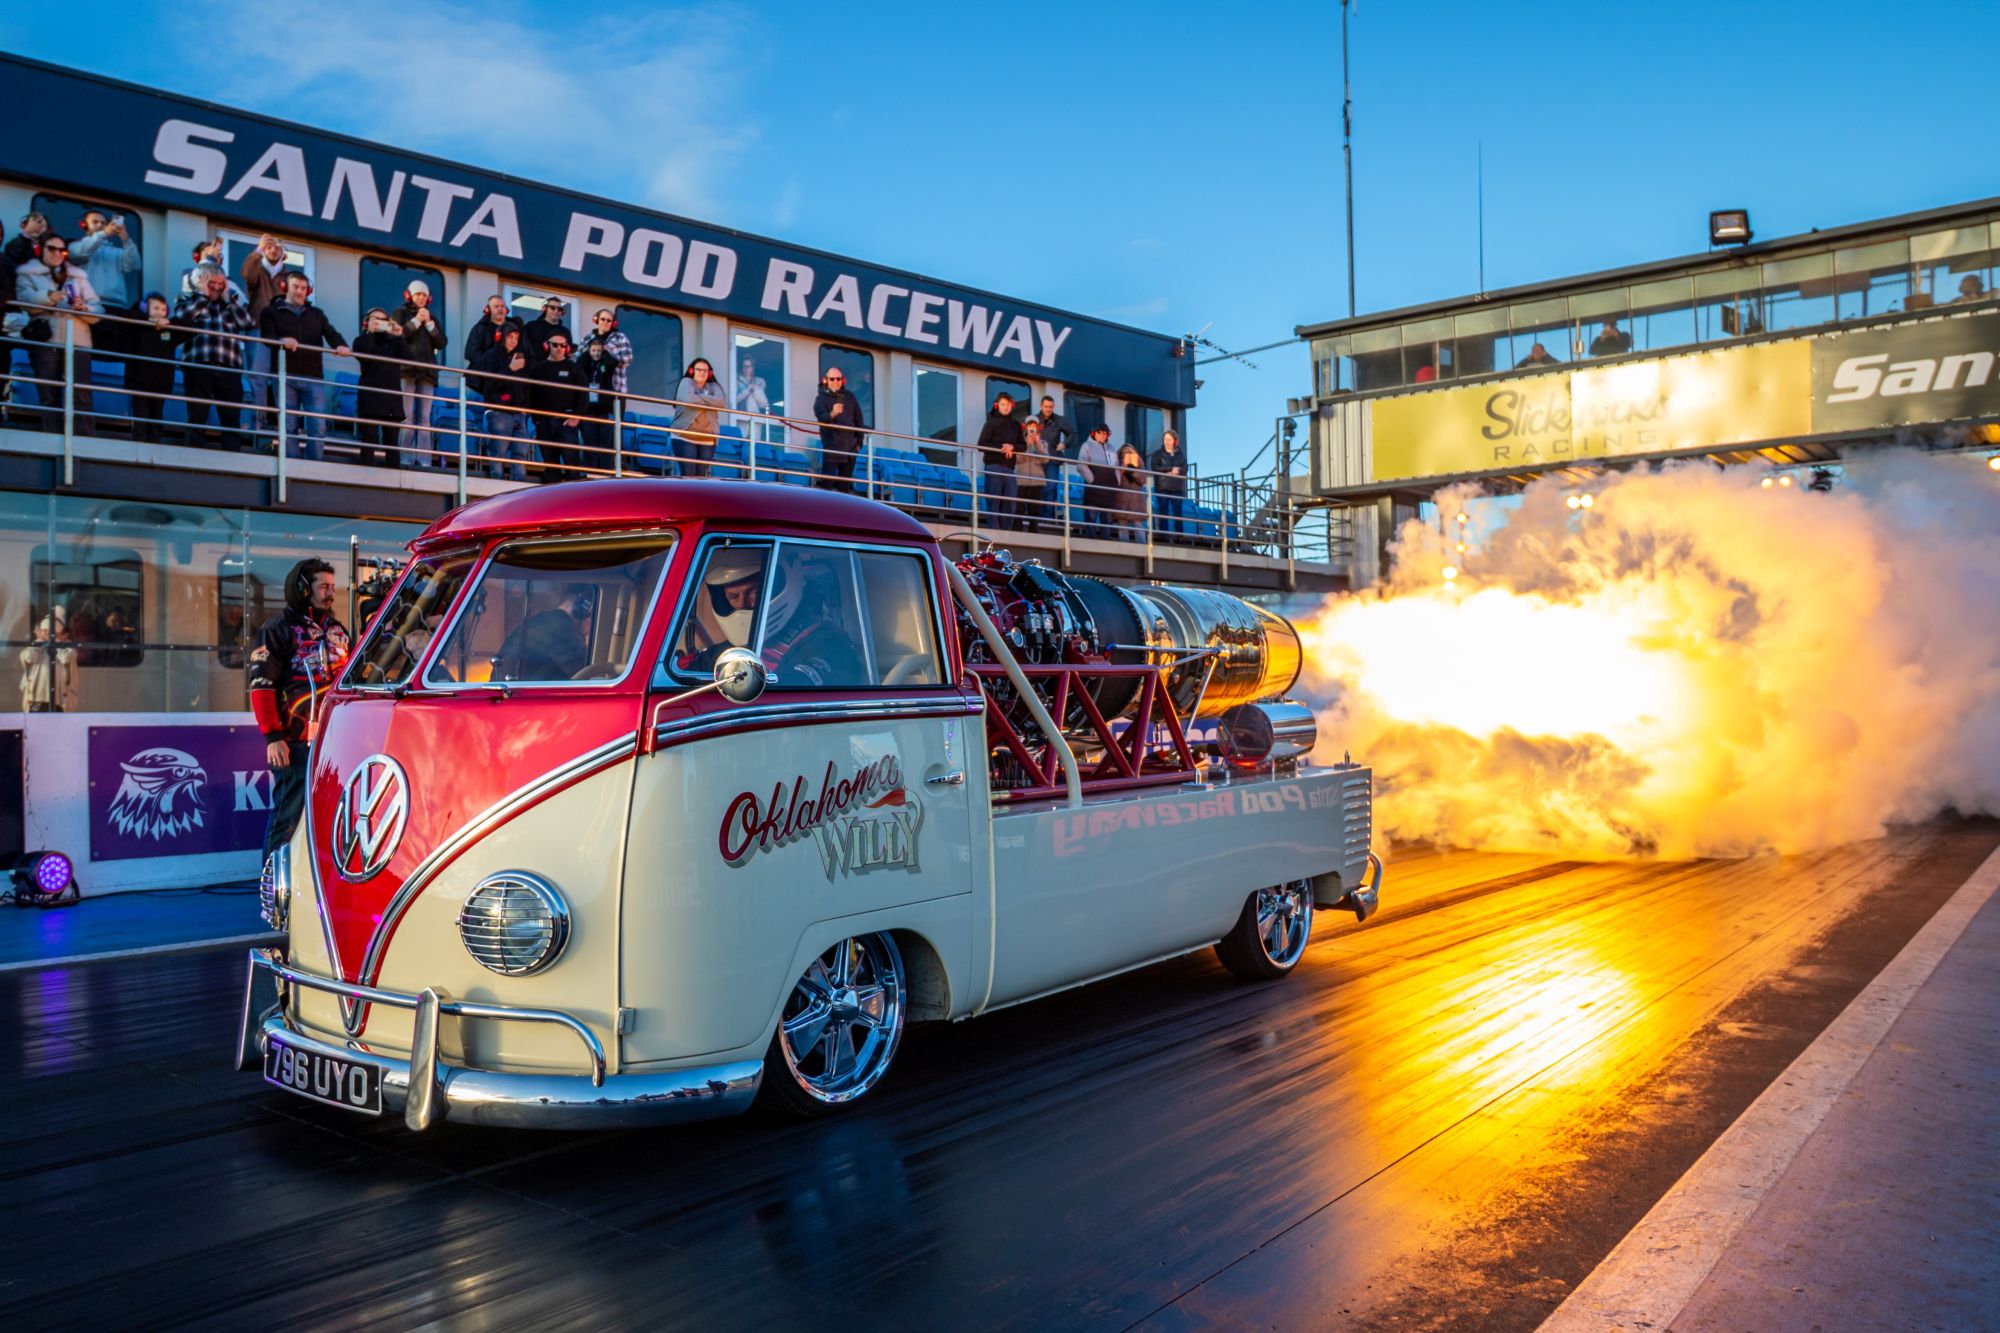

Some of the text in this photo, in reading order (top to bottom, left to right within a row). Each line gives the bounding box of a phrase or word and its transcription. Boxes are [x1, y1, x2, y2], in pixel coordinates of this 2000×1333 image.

[144, 119, 1072, 370] SANTA POD RACEWAY
[1826, 351, 2000, 404] San
[1493, 429, 1657, 461] RACING
[719, 754, 903, 867] Oklahoma
[808, 785, 925, 884] WILLY
[271, 1041, 368, 1105] 796 UYO
